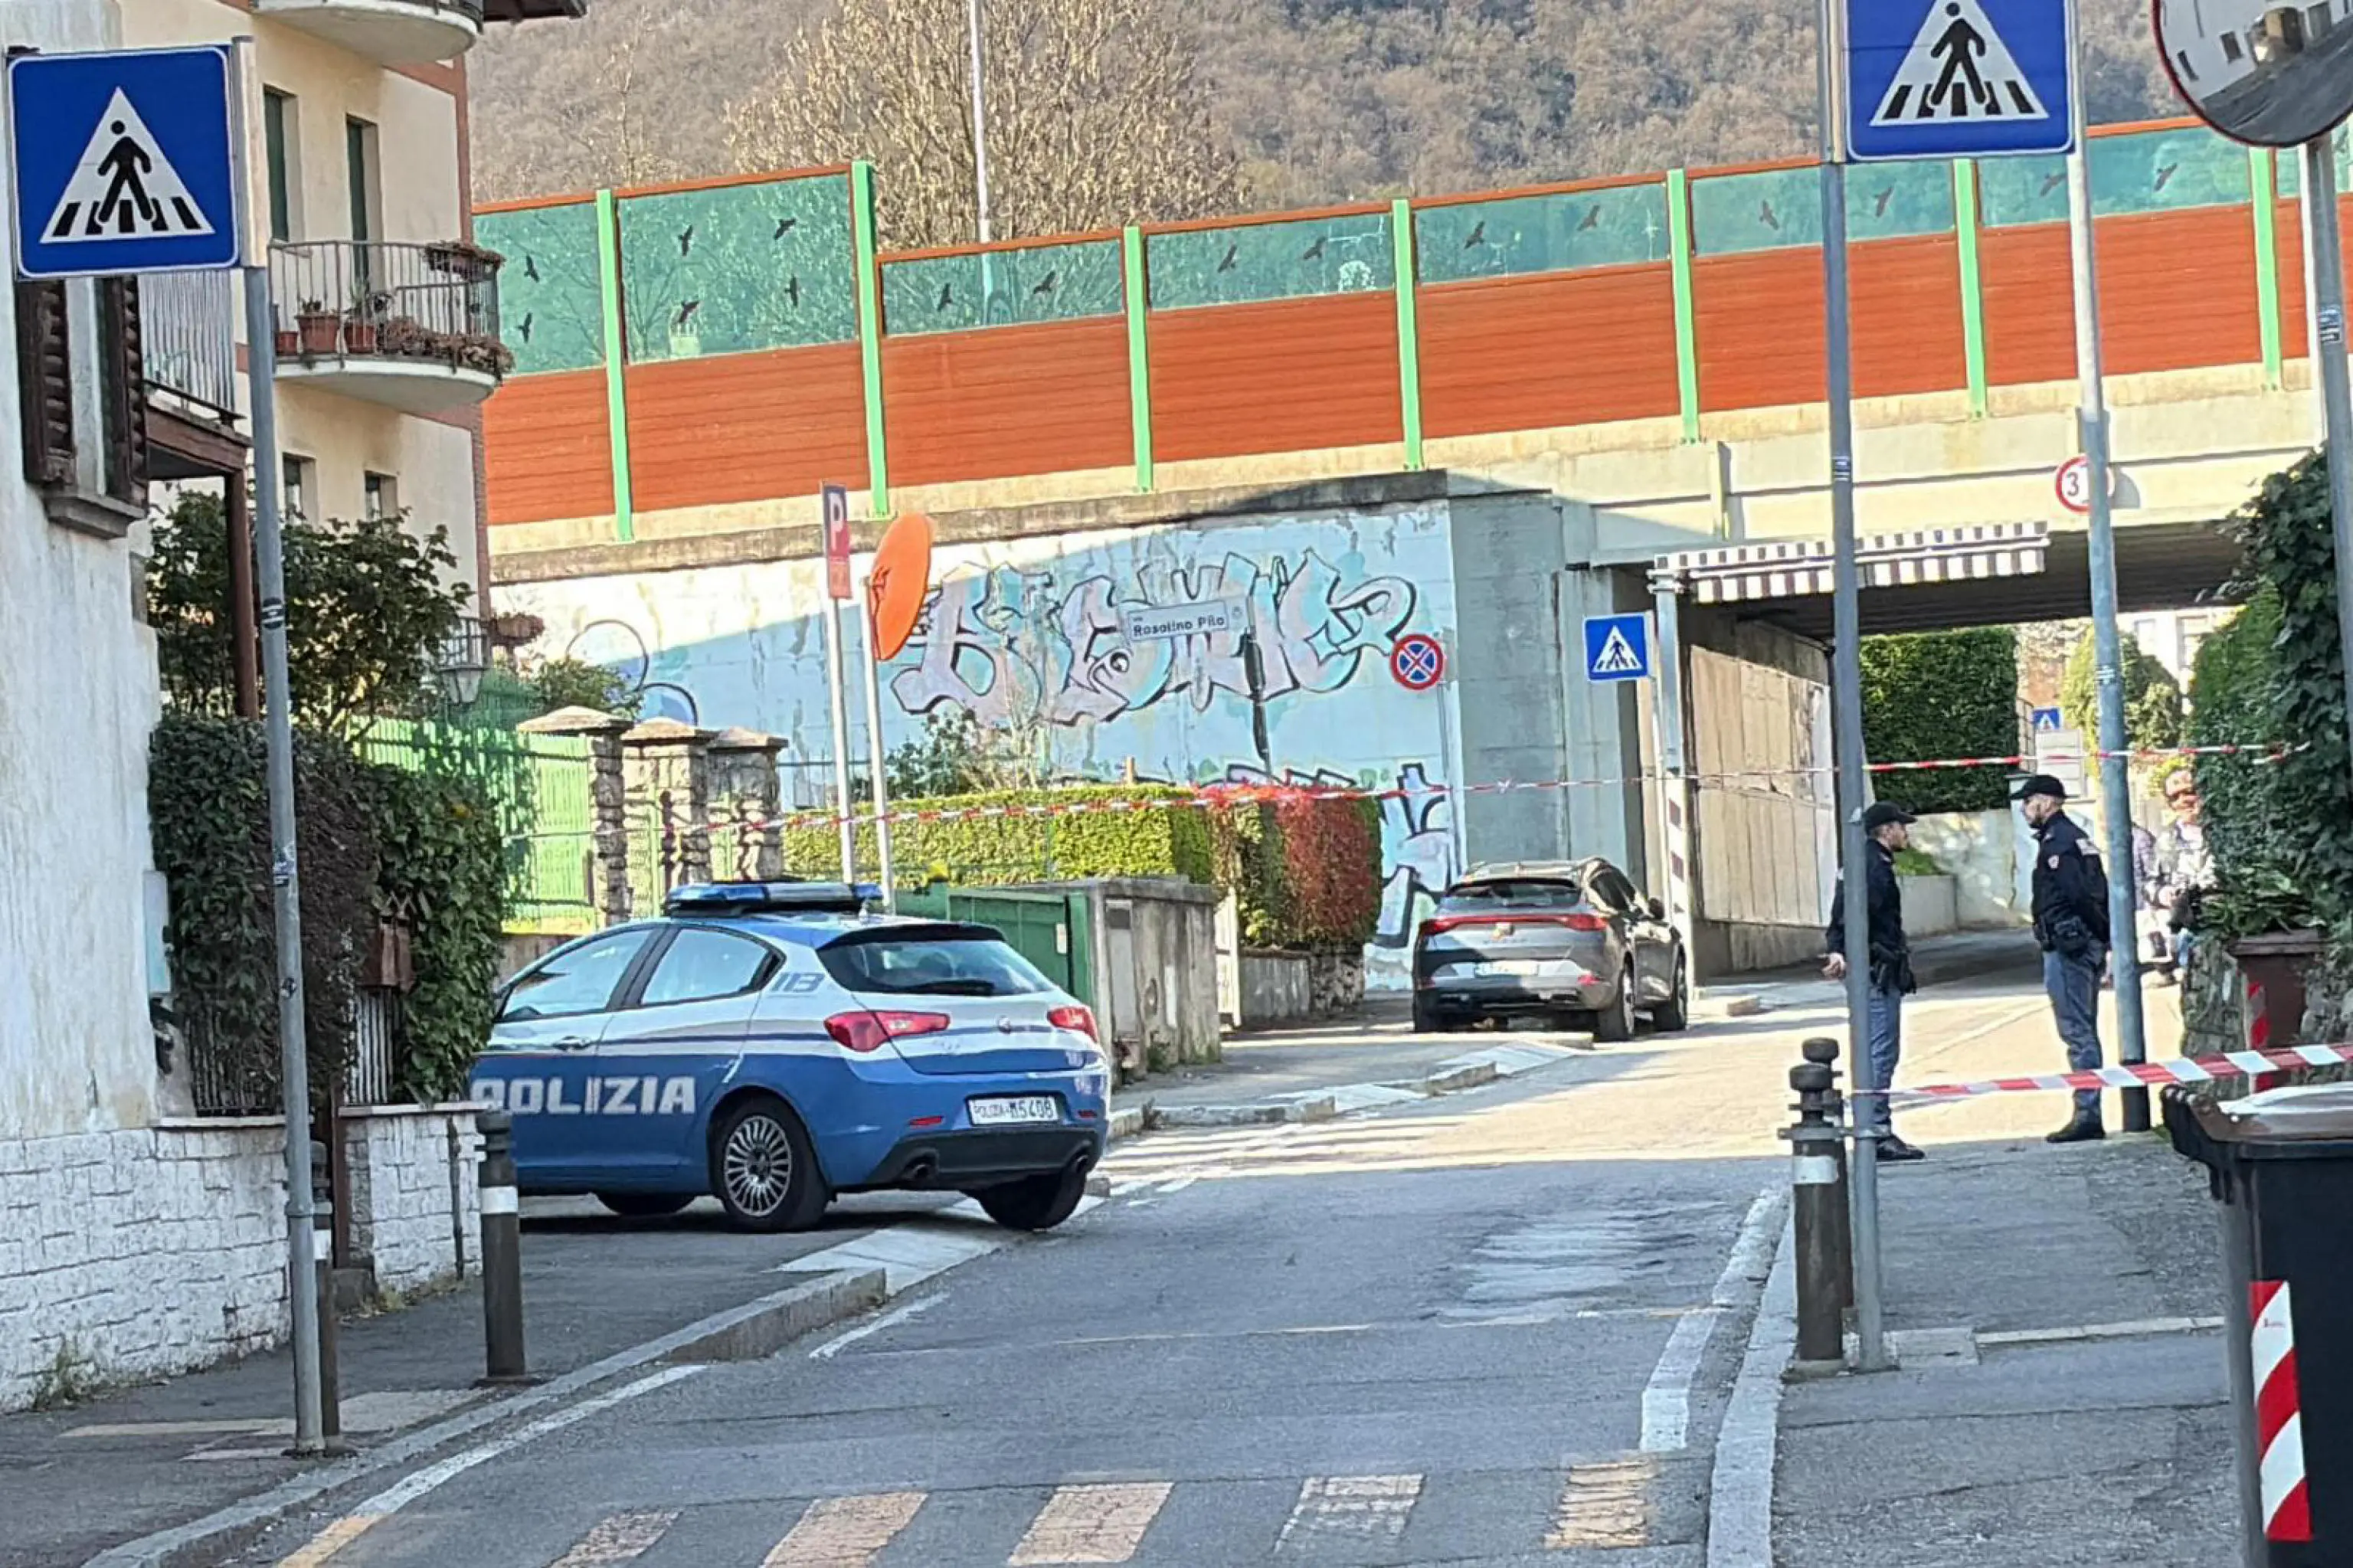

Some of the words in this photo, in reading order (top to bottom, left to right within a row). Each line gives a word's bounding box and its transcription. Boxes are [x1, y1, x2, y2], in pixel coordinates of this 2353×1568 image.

[830, 493, 843, 551] P
[1134, 620, 1193, 637] Rosolino
[470, 1076, 695, 1115] POLIZIA
